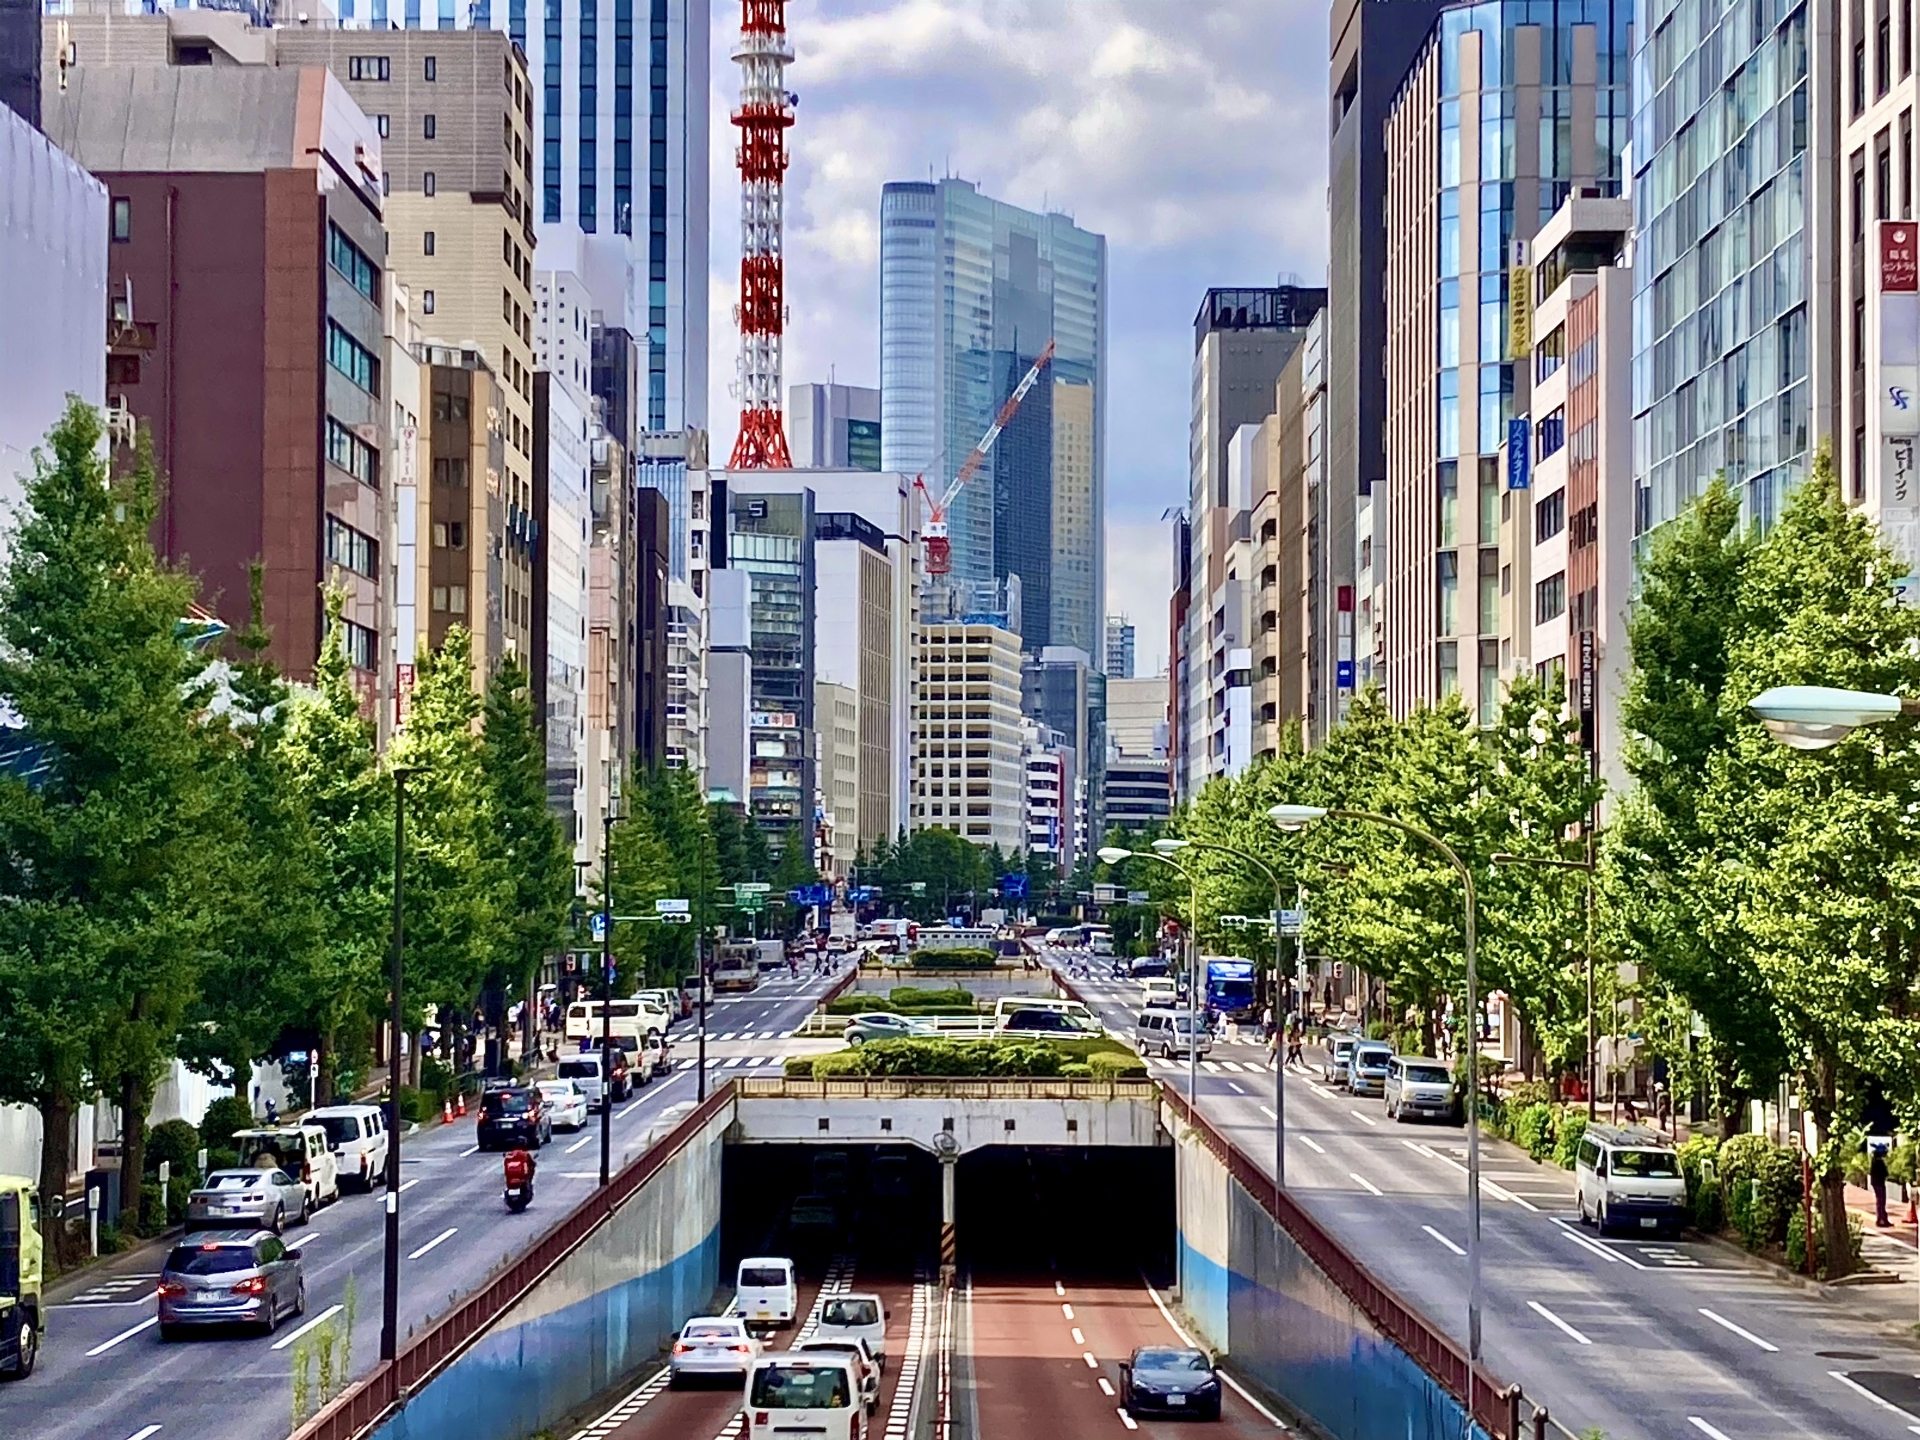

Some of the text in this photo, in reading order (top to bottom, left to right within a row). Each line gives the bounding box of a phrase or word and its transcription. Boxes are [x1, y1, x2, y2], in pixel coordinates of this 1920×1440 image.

[1895, 449, 1907, 501] ビーイング
